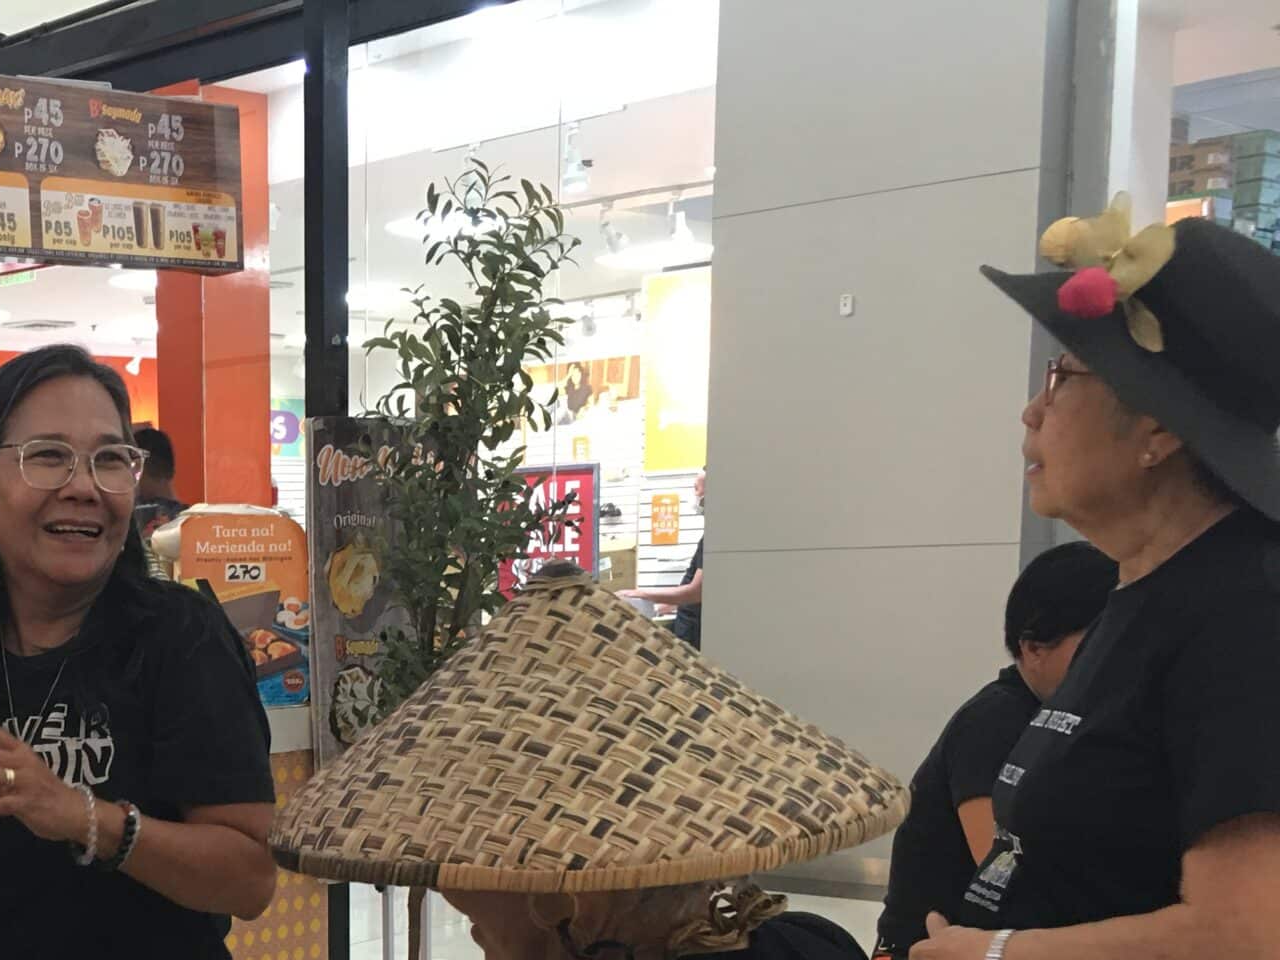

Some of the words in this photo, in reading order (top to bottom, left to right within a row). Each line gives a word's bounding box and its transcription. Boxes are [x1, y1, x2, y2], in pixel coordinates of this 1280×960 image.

[24, 98, 64, 127] P45
[147, 114, 184, 141] P45
[14, 137, 64, 164] P270
[139, 151, 184, 177] P270
[103, 224, 134, 242] P105
[169, 230, 192, 243] P105
[212, 525, 247, 538] Tara
[251, 523, 275, 537] na!
[196, 541, 265, 554] Merienda
[269, 540, 293, 553] na!
[228, 564, 261, 580] 270
